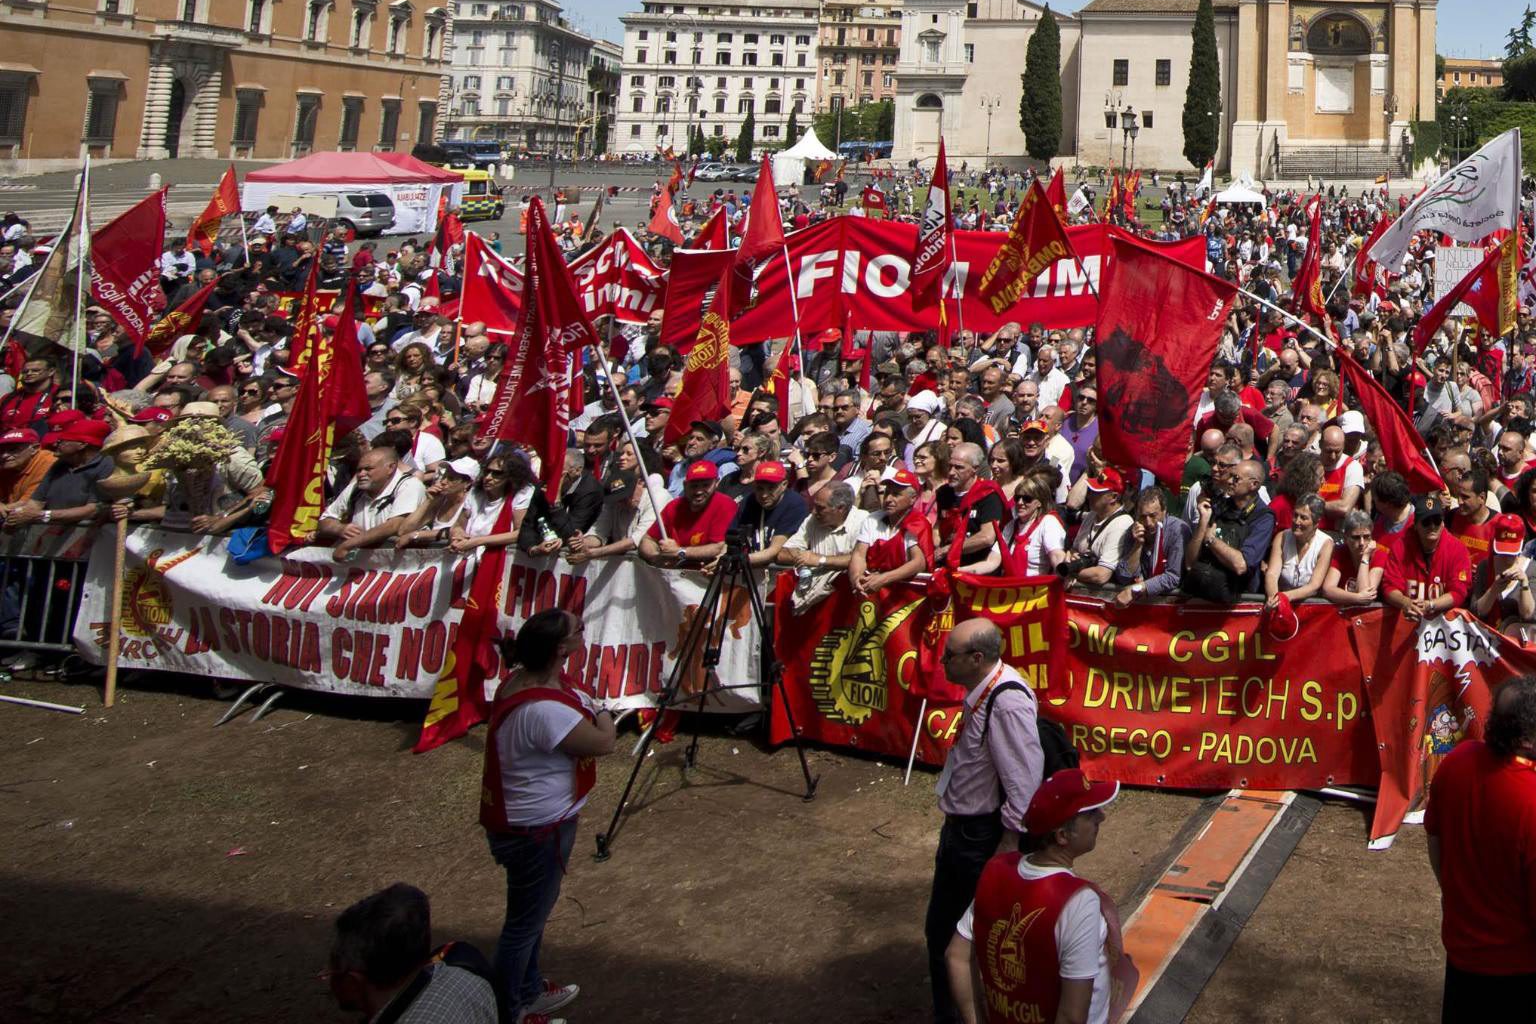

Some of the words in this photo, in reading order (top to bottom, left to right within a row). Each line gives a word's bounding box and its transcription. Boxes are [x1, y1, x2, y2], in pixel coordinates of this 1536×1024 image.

[580, 282, 657, 313] imini
[262, 558, 333, 613] NOI
[326, 565, 438, 624] SIAMO
[955, 581, 1049, 614] FIOM
[184, 607, 222, 656] LA
[219, 608, 322, 674] STORIA
[331, 627, 391, 688] CHE
[396, 619, 459, 682] NO
[1168, 629, 1277, 663] CGIL
[850, 685, 885, 709] FIOM
[1083, 667, 1291, 721] DRIVETECH
[1197, 732, 1318, 765] PADOVA
